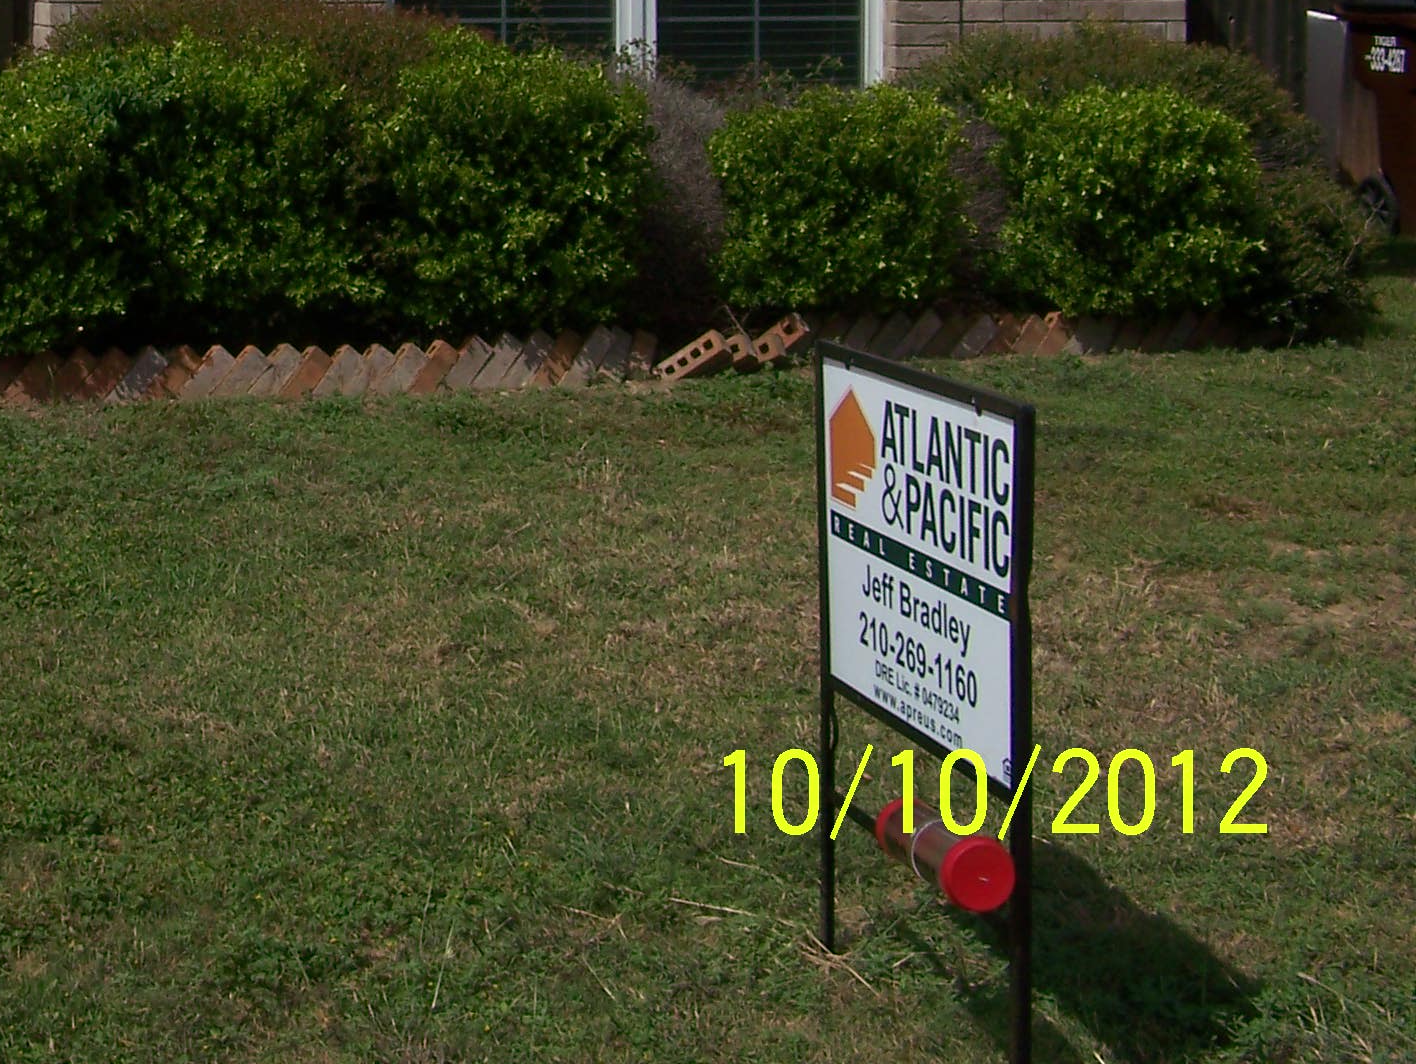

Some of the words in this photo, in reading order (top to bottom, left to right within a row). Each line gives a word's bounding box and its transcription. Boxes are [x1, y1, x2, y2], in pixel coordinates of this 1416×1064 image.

[880, 399, 1010, 507] ATLANTIC
[833, 515, 886, 557] REAL
[908, 552, 1007, 613] ESTATE
[861, 564, 895, 610] Jeff
[899, 581, 971, 658] Bradley
[859, 611, 978, 709] 210-269-1160
[875, 659, 895, 686] DRE
[873, 683, 963, 749] www.apreus.com
